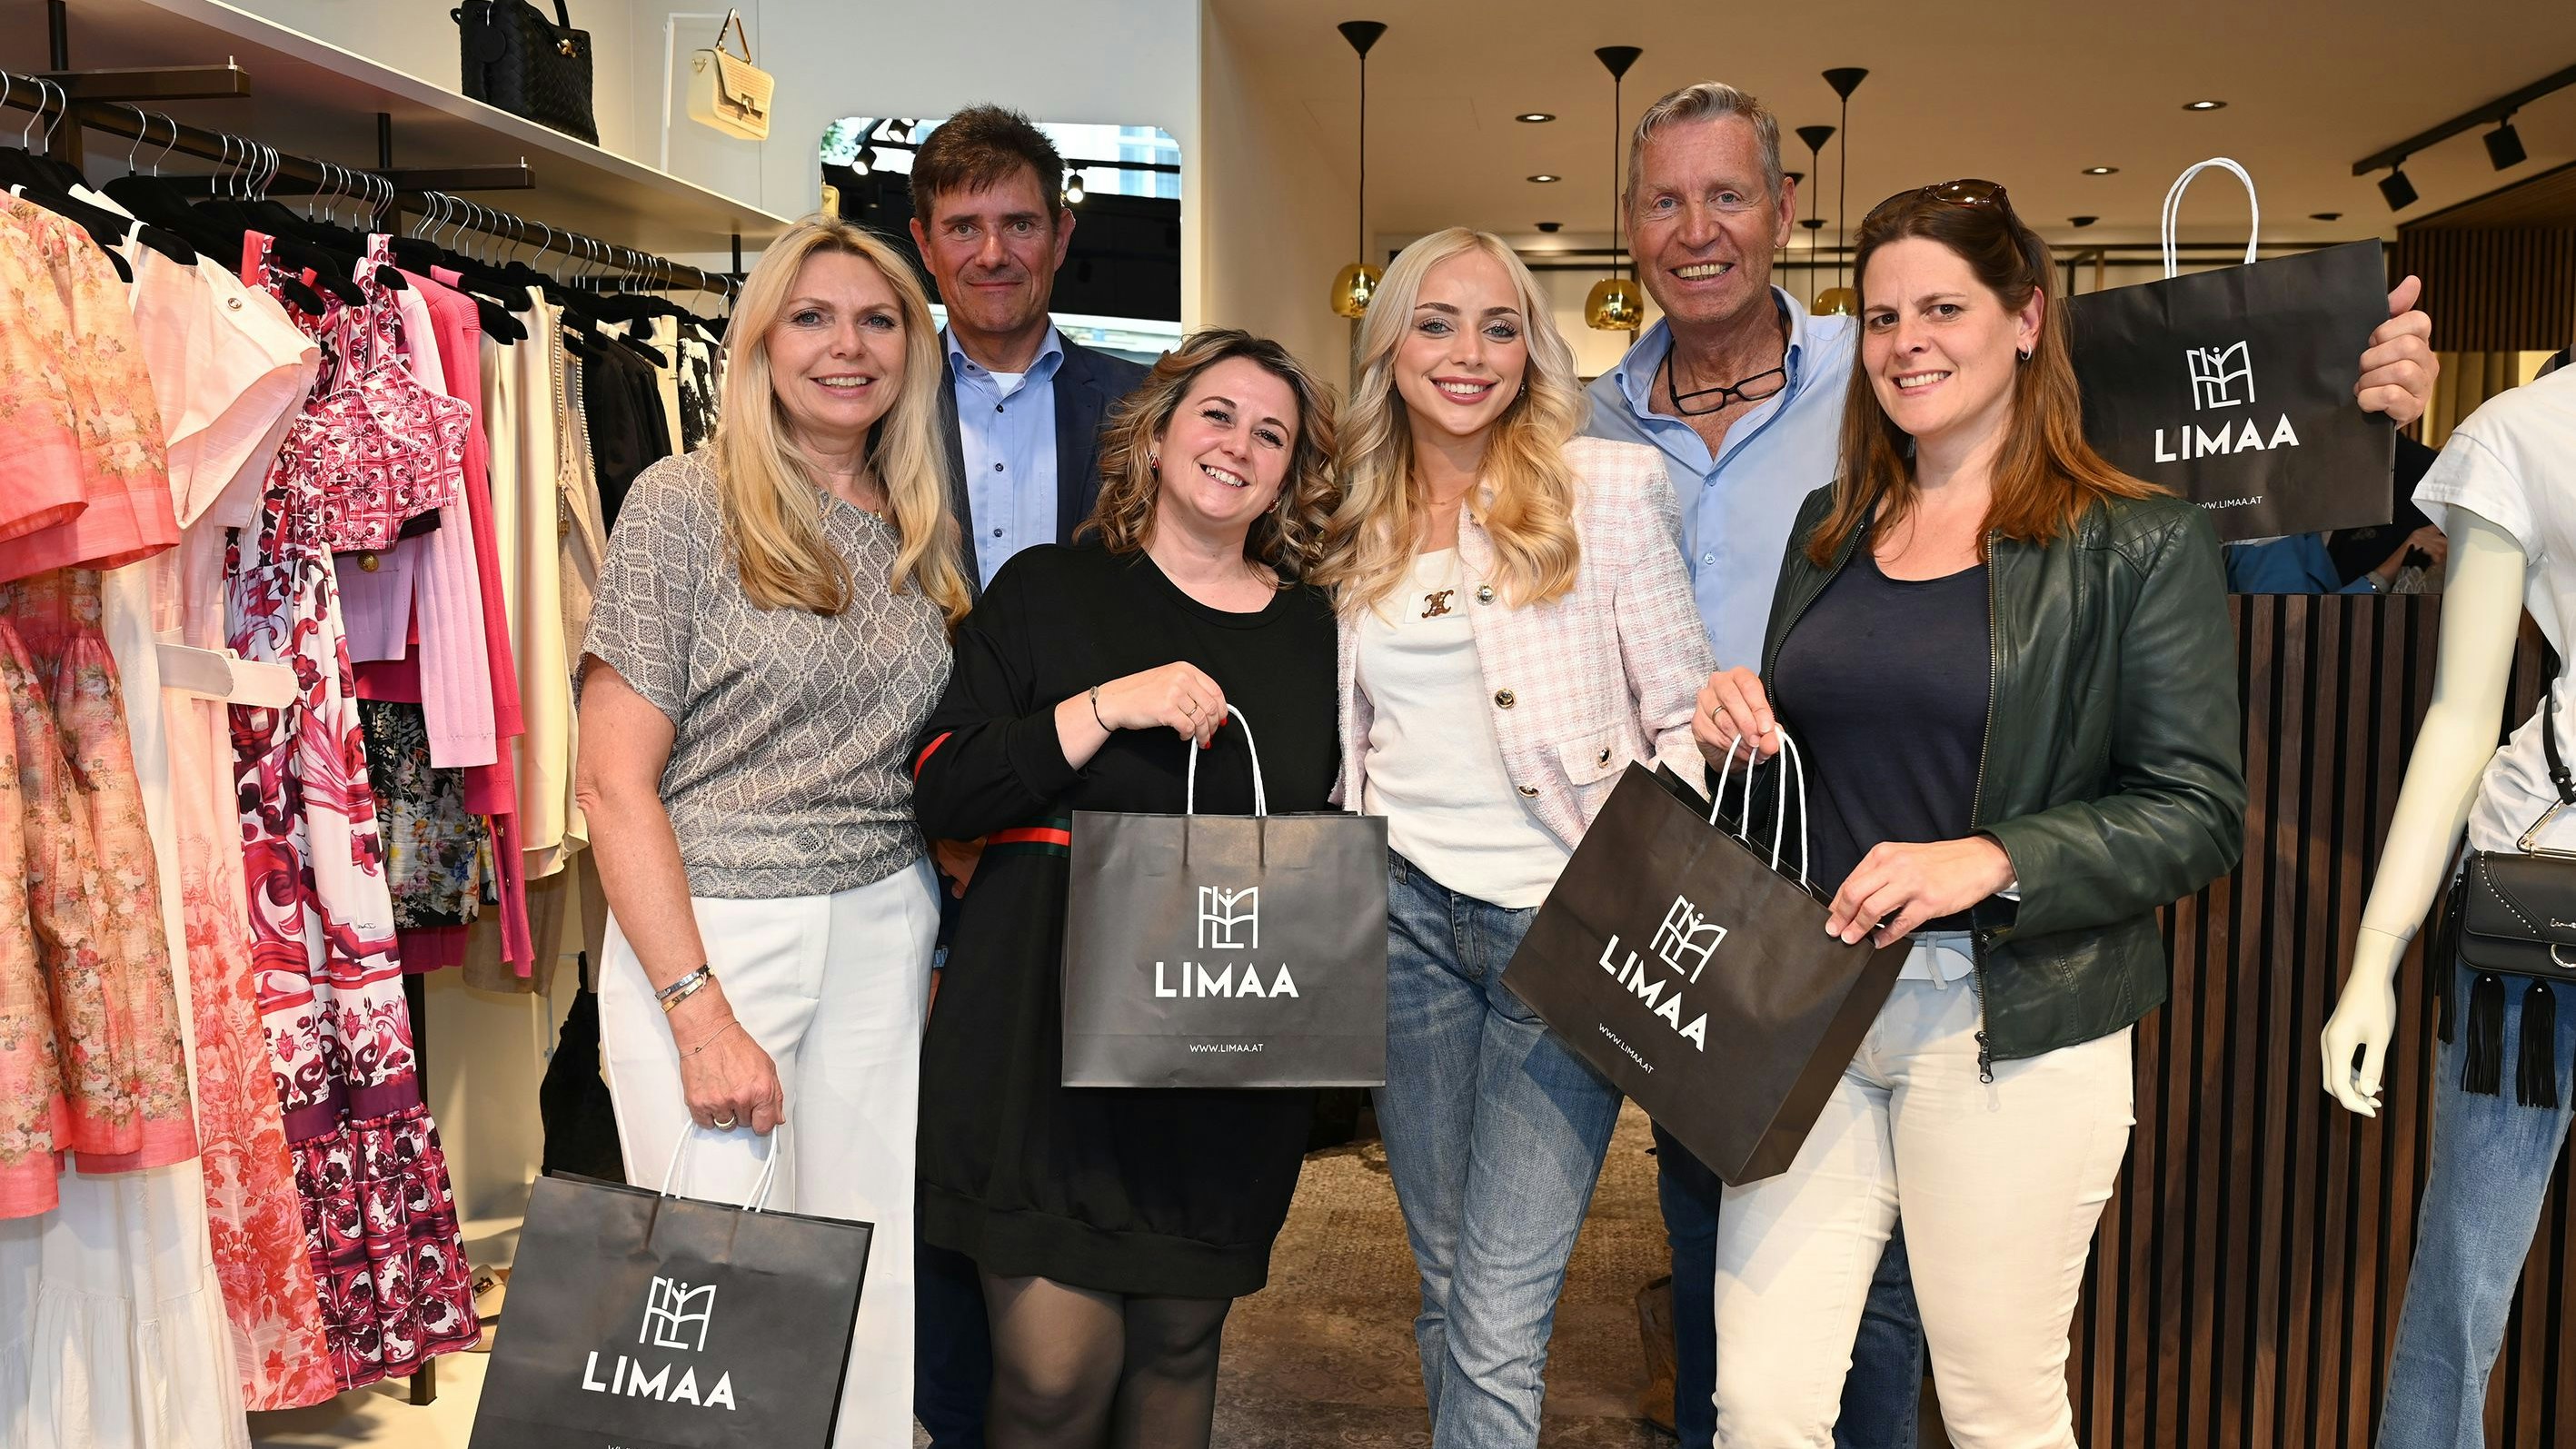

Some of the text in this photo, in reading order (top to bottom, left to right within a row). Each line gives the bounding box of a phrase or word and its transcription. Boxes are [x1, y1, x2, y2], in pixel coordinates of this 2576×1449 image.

[2155, 413, 2300, 463] LIMAA
[1155, 961, 1299, 998] LIMAA
[1599, 934, 1707, 1053] LIMAA
[1189, 1044, 1264, 1053] WWW.LIMAA.AT
[1599, 1023, 1654, 1074] WWW.LIMAA.AT
[582, 1350, 736, 1411] LIMAA
